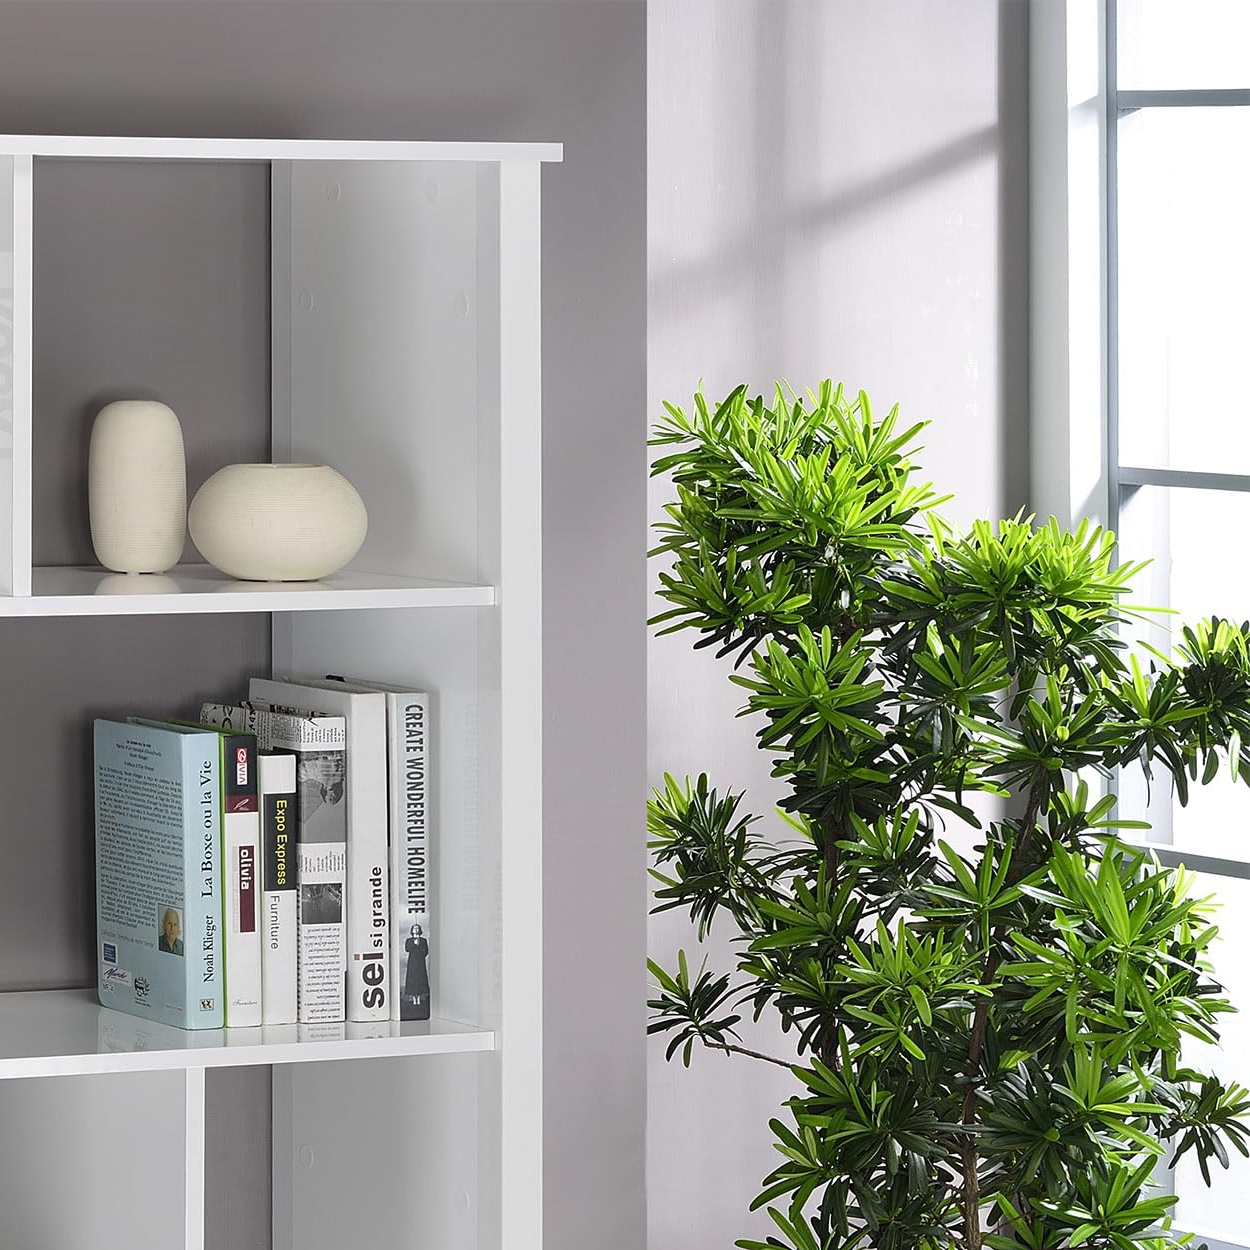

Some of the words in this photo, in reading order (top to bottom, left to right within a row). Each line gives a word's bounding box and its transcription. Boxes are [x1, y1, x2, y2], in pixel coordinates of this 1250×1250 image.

[405, 704, 424, 753] CREATE
[199, 760, 211, 787] Vie
[200, 791, 212, 805] la
[274, 799, 288, 832] Expo
[406, 757, 425, 842] WONDERFUL
[204, 809, 212, 829] ou
[201, 833, 213, 872] Boxe
[240, 849, 253, 890] olivia
[274, 834, 288, 885] Express
[201, 878, 213, 898] La
[369, 866, 386, 928] grande
[407, 847, 426, 914] HOMELIFE
[203, 914, 217, 951] Klieger
[270, 895, 281, 950] Furniture
[370, 934, 383, 948] si
[203, 953, 214, 983] Noah
[353, 952, 385, 1009] sei
